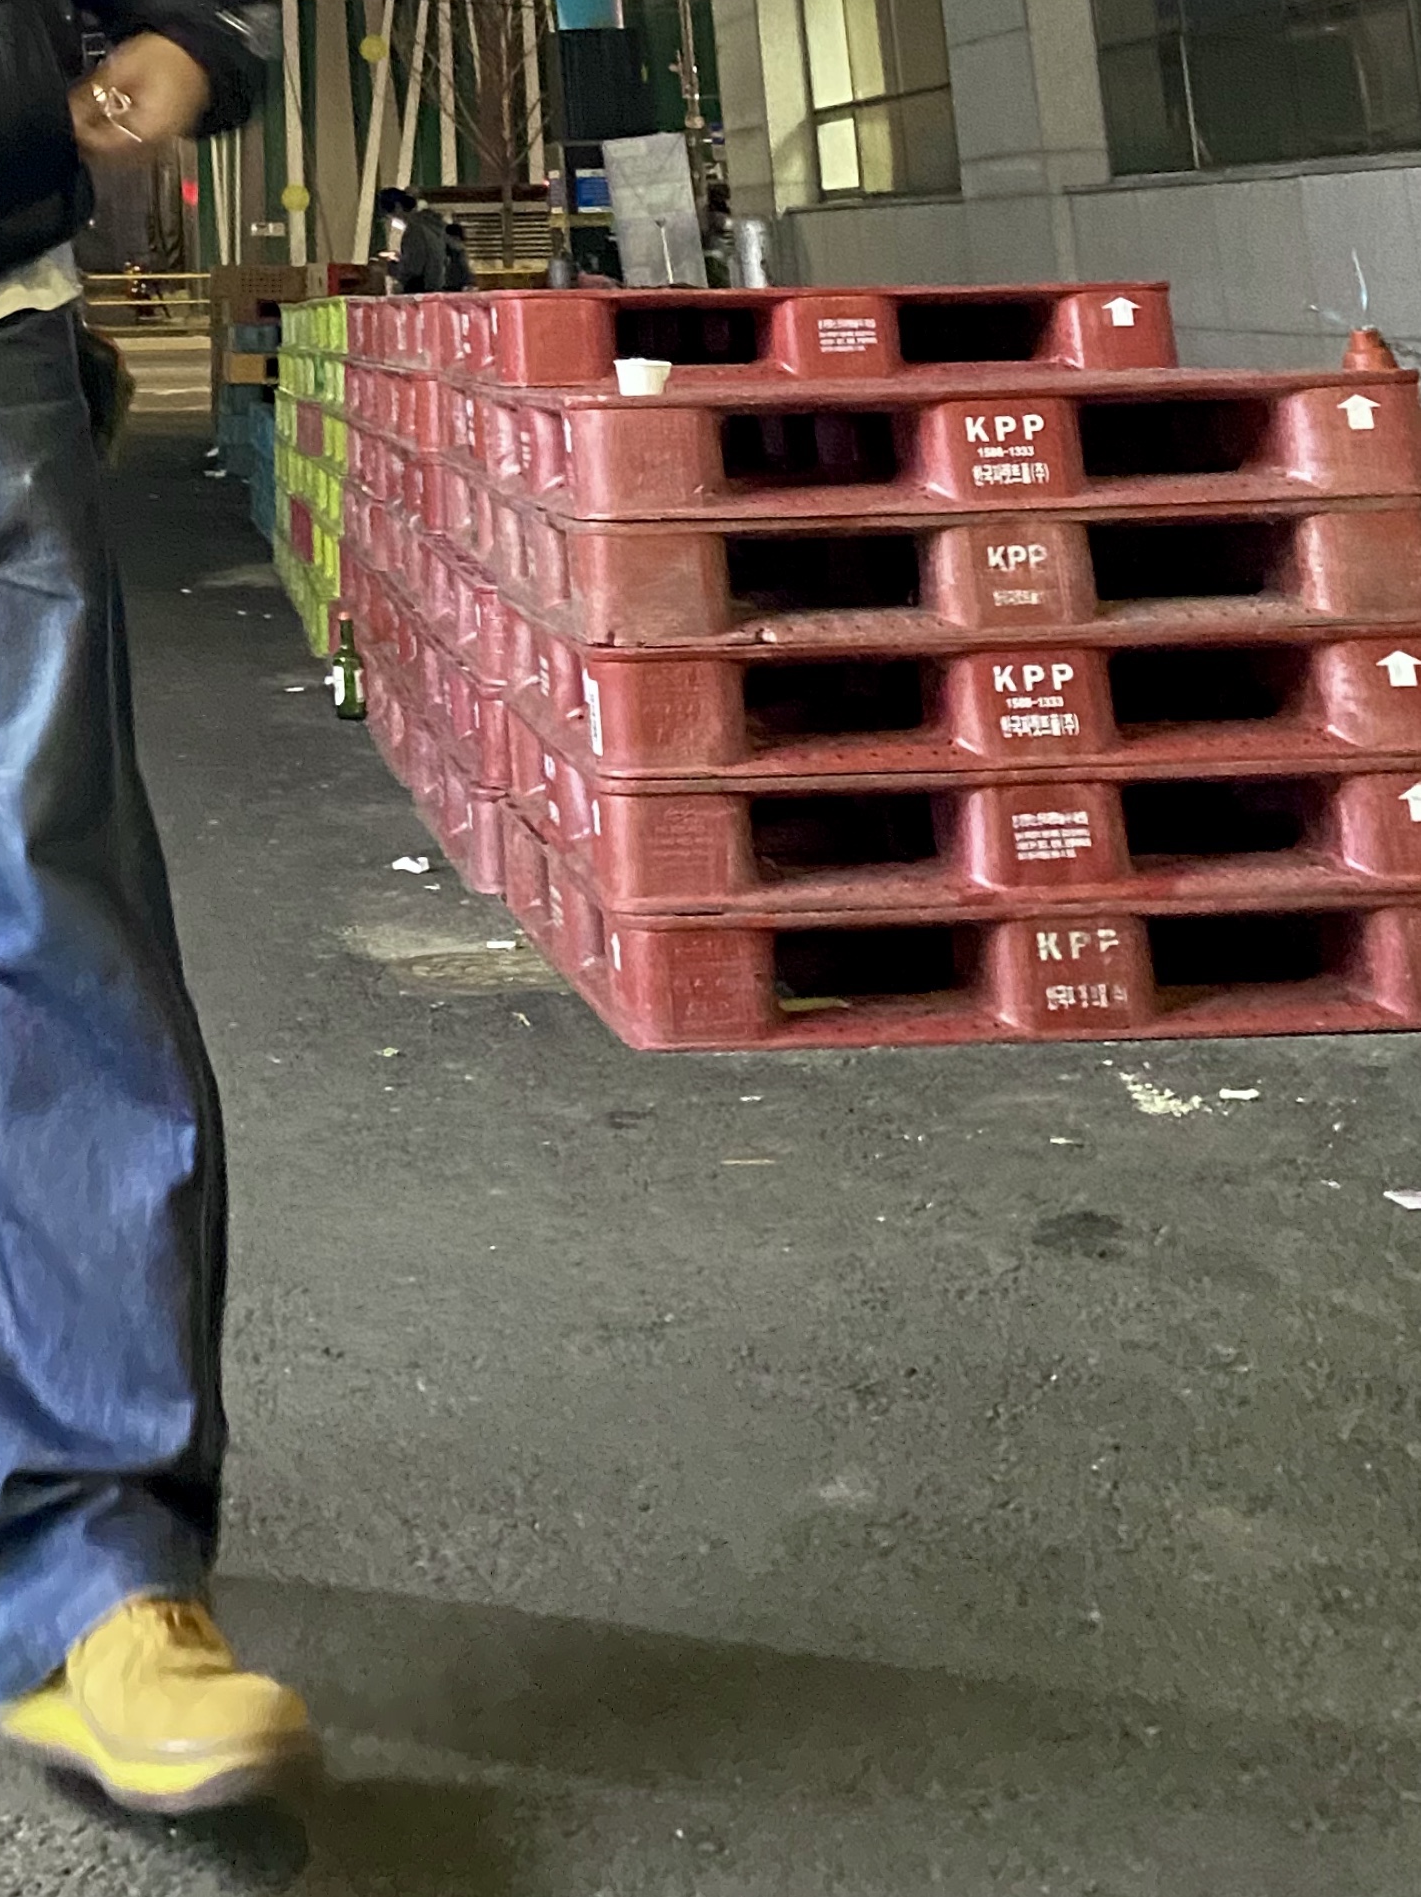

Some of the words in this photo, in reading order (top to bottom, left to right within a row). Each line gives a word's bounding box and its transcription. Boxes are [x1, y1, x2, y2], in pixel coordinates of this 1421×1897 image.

[965, 414, 1045, 442] KPP
[987, 545, 1047, 572] KPP
[993, 663, 1074, 692] KPP
